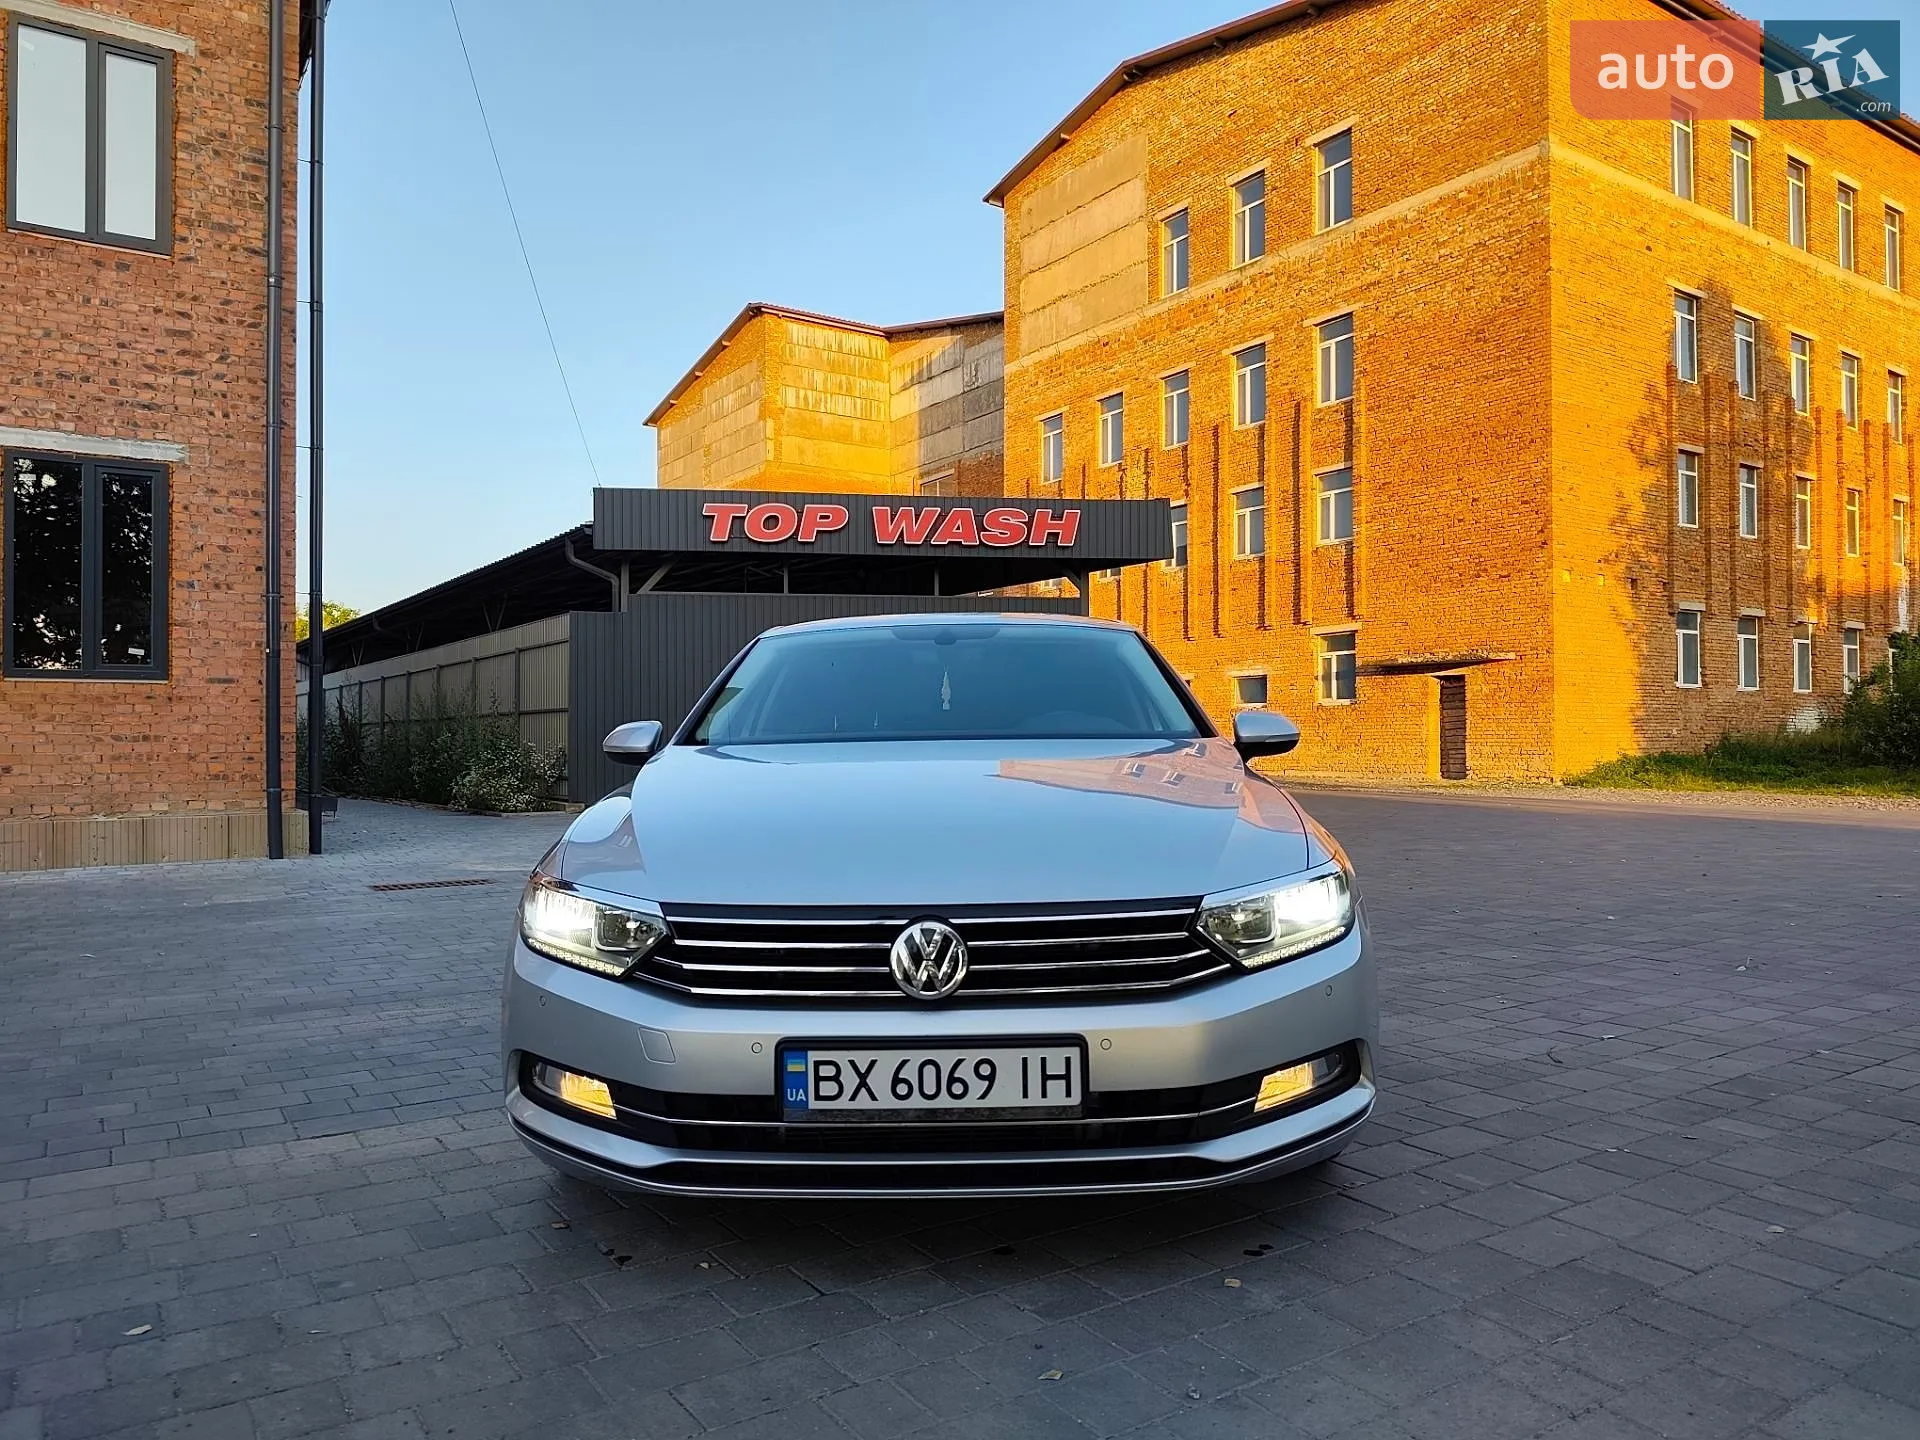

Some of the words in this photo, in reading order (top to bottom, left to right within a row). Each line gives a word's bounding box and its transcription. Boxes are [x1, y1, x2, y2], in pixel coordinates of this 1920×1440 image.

[702, 502, 849, 543] TOP
[872, 506, 1081, 547] WASH
[787, 1088, 806, 1102] UA
[812, 1058, 879, 1102] BX
[890, 1057, 997, 1101] 6069
[1021, 1056, 1072, 1099] IH
